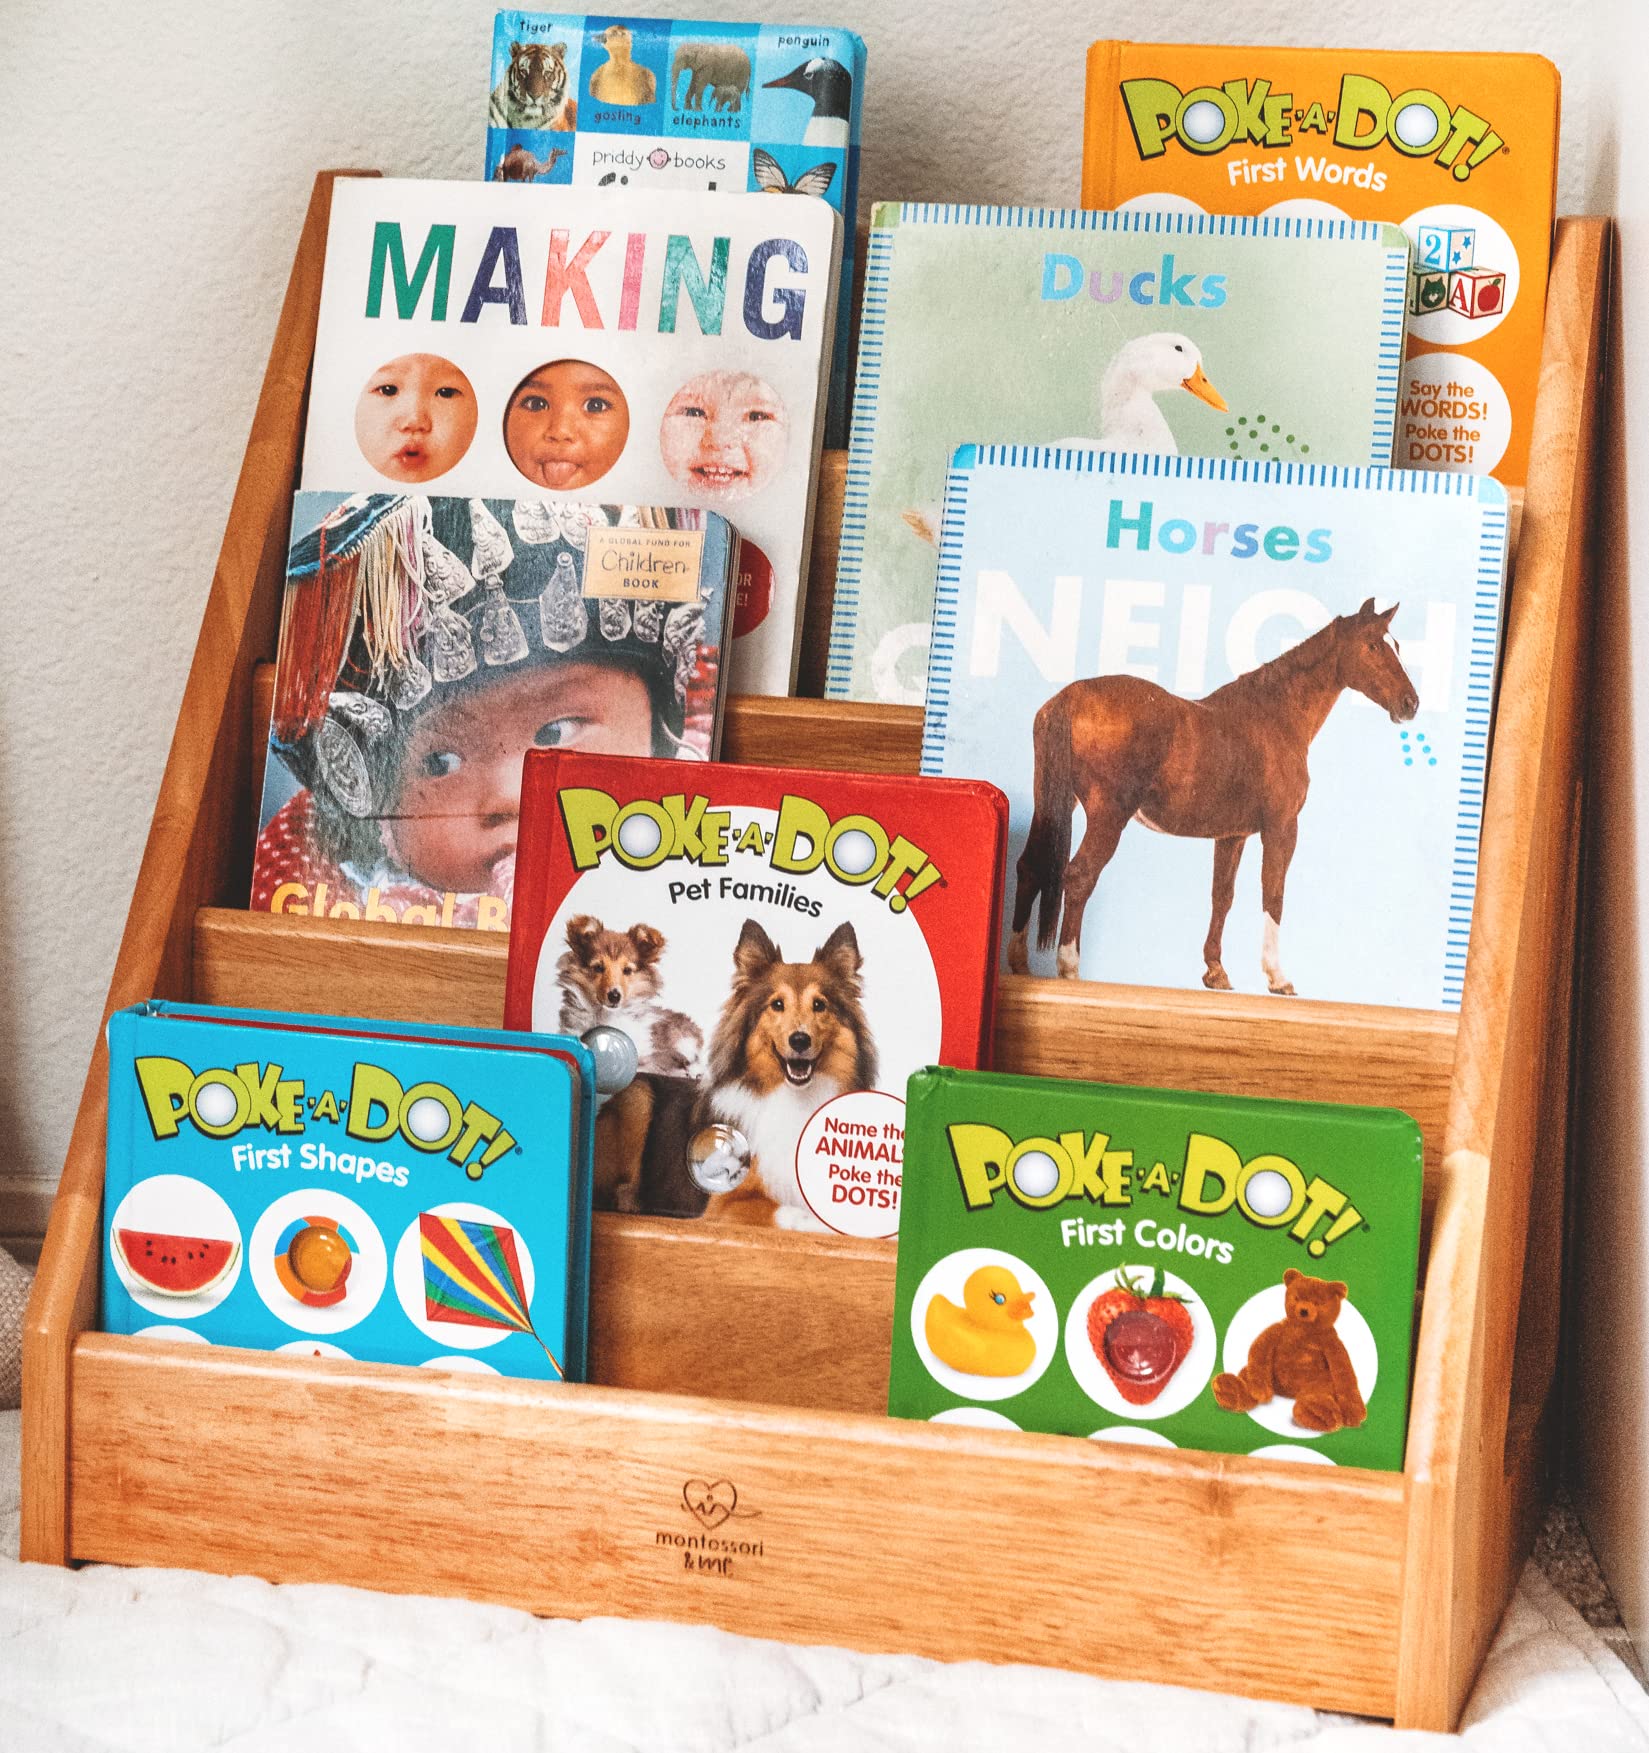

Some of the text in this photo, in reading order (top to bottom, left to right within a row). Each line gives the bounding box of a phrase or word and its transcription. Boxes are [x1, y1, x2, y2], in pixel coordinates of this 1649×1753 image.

[519, 20, 553, 35] tiger
[777, 34, 830, 49] penguin
[593, 110, 641, 126] gosling
[673, 114, 741, 129] elephants
[592, 150, 726, 171] priddy books
[1227, 157, 1388, 192] First Words
[364, 221, 809, 341] MAKING
[1041, 253, 1228, 308] Ducks
[1410, 380, 1474, 399] Say the
[1400, 399, 1488, 420] WORDS!
[1405, 424, 1480, 442] Poke the
[1408, 442, 1474, 464] DOTS!
[608, 537, 641, 546] GLOBAL
[646, 539, 670, 547] FUND
[673, 540, 691, 548] FOR
[1106, 499, 1334, 564] Horses
[601, 549, 687, 574] Children
[623, 578, 660, 589] BOOK
[668, 877, 824, 918] Pet Families
[824, 1117, 878, 1138] Name
[815, 1136, 905, 1164] ANIMAL
[231, 1142, 411, 1187] First Shapes
[828, 1163, 903, 1187] Poke the
[831, 1184, 898, 1210] DOTS!
[1060, 1217, 1235, 1264] First Colors
